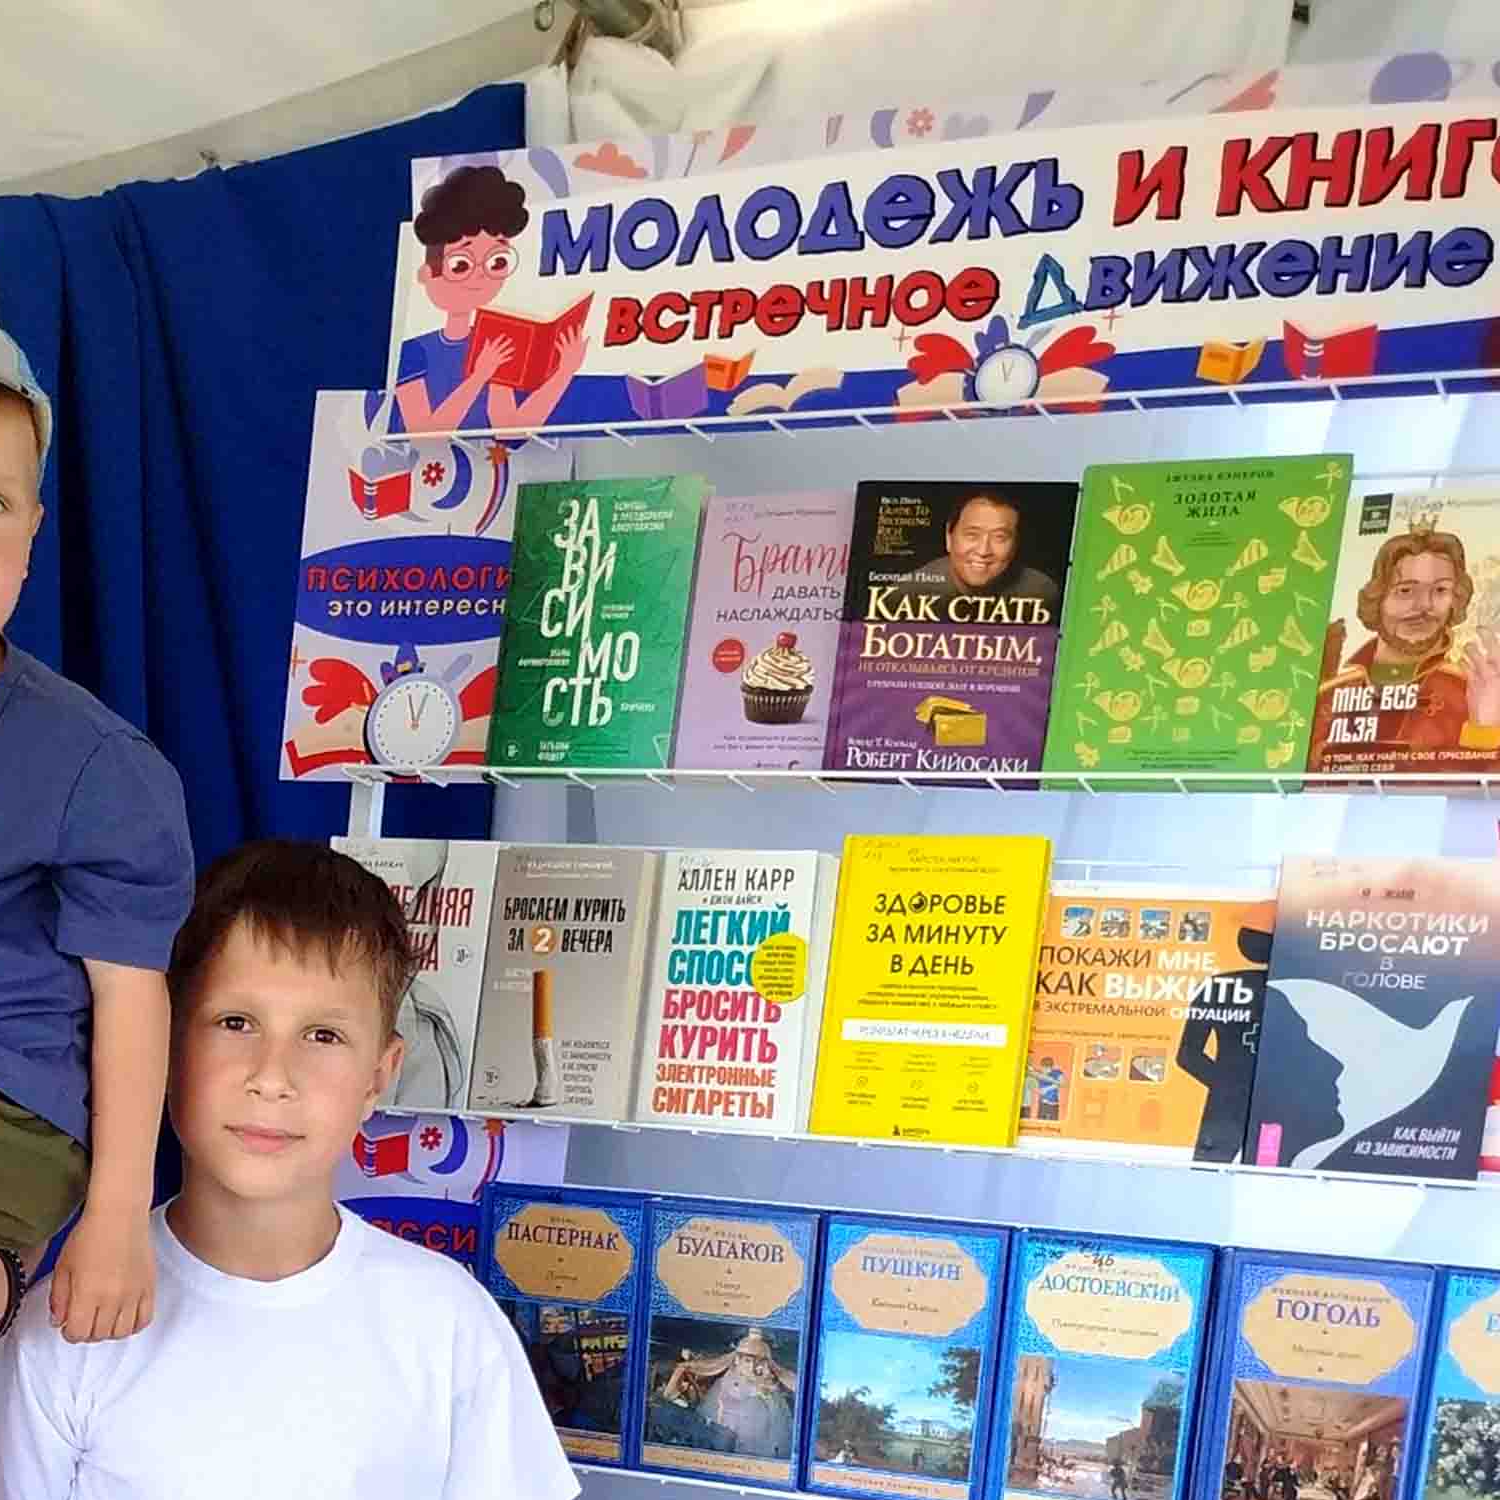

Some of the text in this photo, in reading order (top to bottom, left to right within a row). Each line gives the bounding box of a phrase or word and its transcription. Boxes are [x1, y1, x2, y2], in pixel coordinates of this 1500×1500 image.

[1113, 146, 1187, 226] И
[1216, 117, 1500, 217] КНИГ
[306, 563, 512, 594] ПСИХОЛОГИ
[380, 598, 507, 617] ИНТЕРЕСН
[716, 606, 845, 623] НАСЛАЖДАТЬС
[678, 868, 796, 892] АЛЛЕН КАРР
[504, 896, 626, 923] БРОСАЕМ КУРИТЬ
[1306, 909, 1490, 935] НАРКОТИКИ
[672, 903, 792, 945] ЛЕГКИЙ
[866, 923, 1009, 945] ЗА МИНУТУ
[508, 927, 613, 953] ЗА 2 ВЕЧЕРА
[1319, 932, 1469, 957] БРОСАЮТ
[667, 949, 754, 986] СПОС
[890, 953, 975, 977] В ДЕНЬ
[1039, 945, 1151, 969] ПОКАЖИ
[1379, 957, 1394, 971] В
[1036, 970, 1254, 1004] КАК ВЫЖИТЬ
[1342, 972, 1427, 991] ГОЛОВЕ
[662, 989, 782, 1024] БРОСИТЬ
[658, 1024, 778, 1063] КУРИТЬ
[656, 1062, 777, 1088] ЭЛЕКТРОННЫЕ
[652, 1086, 775, 1120] СИГАРЕТЫ
[507, 1222, 619, 1251] ПАСТЕРНАК
[675, 1236, 786, 1264] БУЛГАКОВ
[861, 1254, 964, 1281] ПУШКИН
[1276, 1298, 1381, 1328] ГОГОЛЬ
